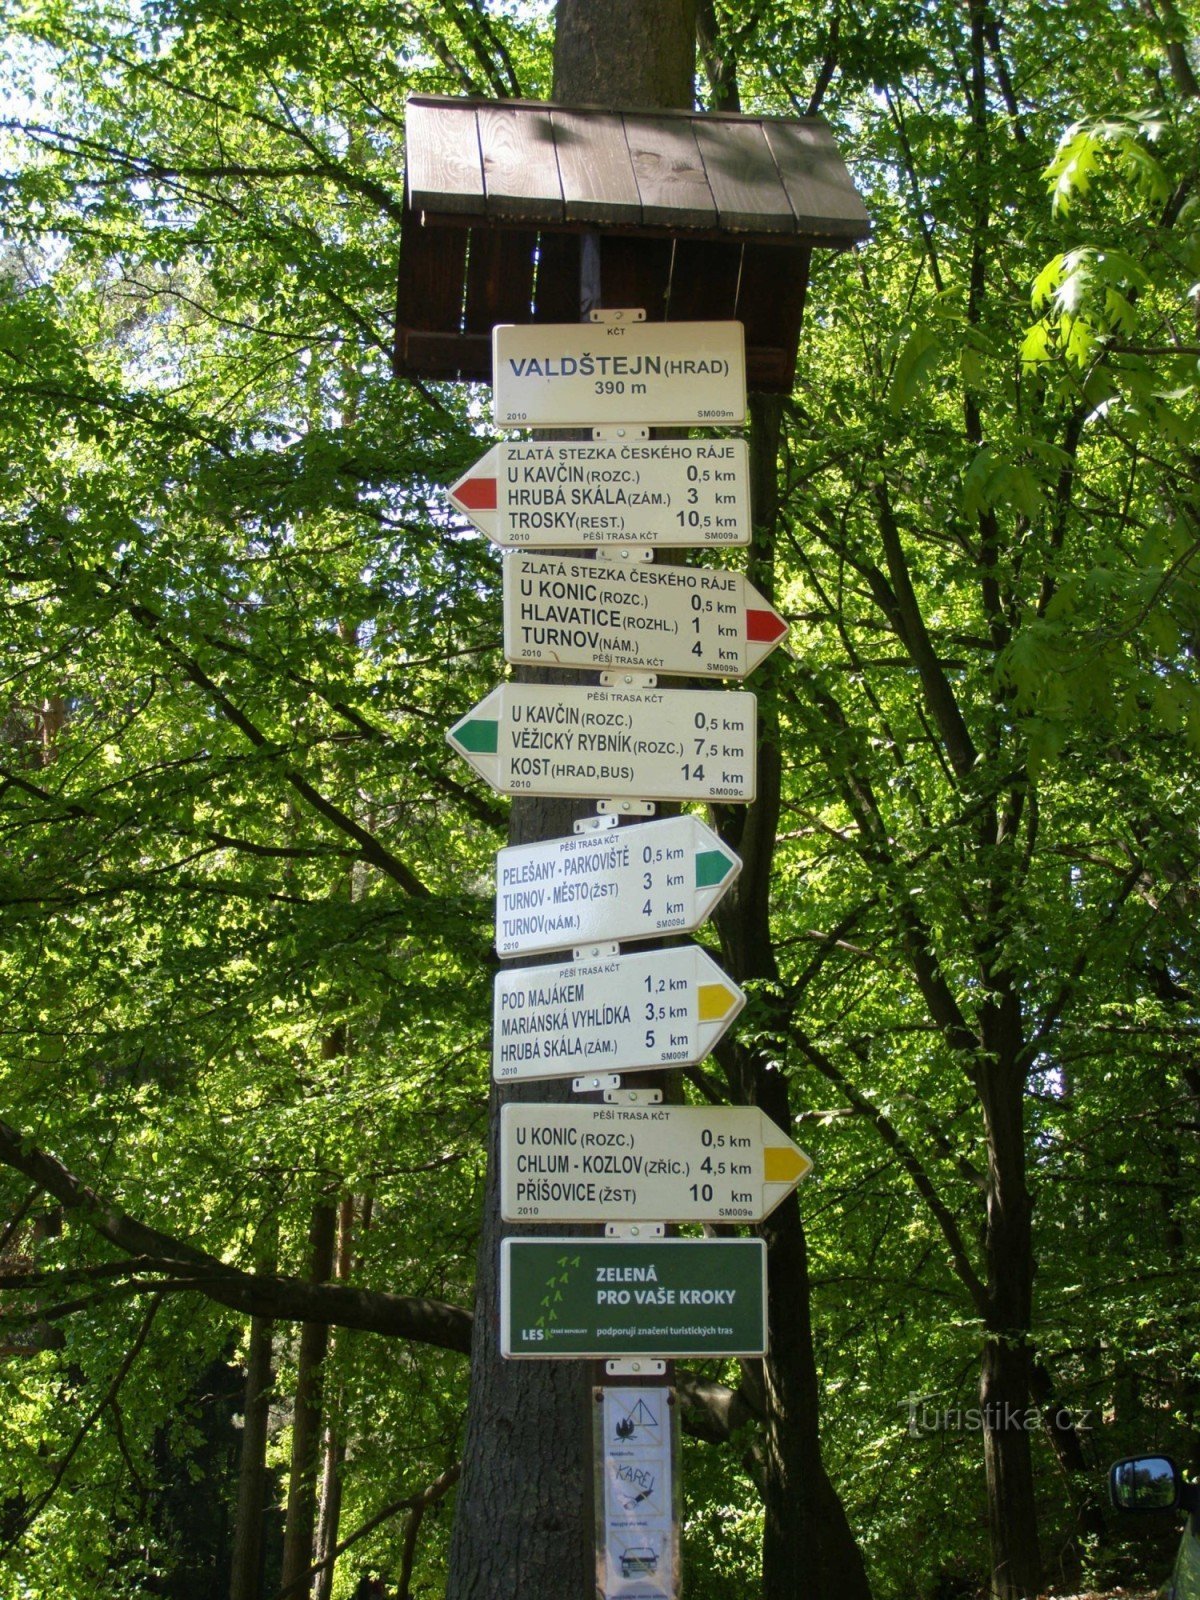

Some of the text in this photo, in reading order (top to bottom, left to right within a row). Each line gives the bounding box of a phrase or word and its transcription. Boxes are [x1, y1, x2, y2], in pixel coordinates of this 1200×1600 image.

[607, 327, 625, 336] KČT
[595, 381, 646, 394] 390 m
[697, 410, 734, 418] SM009m
[507, 444, 735, 461] ZLATÁ STEZKA ČESKÉHO RÁJE
[508, 468, 517, 483] U
[686, 465, 710, 483] 0,5
[715, 470, 736, 481] km
[508, 486, 566, 506] HRUBÁ
[687, 488, 698, 504] 3
[715, 493, 736, 504] km
[677, 511, 711, 528] 10,5
[716, 516, 737, 527] km
[583, 531, 658, 540] PĚŠÍ TRASA KČT
[705, 532, 738, 540] SM009a
[522, 562, 736, 591] ZLATÁ STEZKA ČESKÉHO RÁJE
[521, 579, 532, 596] U
[691, 595, 713, 613] 0,5
[717, 602, 737, 614] km
[692, 617, 700, 633] 1
[718, 625, 738, 637] km
[522, 650, 541, 658] 2010
[692, 642, 703, 657] 4
[718, 649, 738, 660] km
[593, 653, 664, 667] PĚŠÍ TRASA KČT
[707, 663, 738, 672] SM009b
[587, 692, 663, 703] PĚŠÍ TRASA KČT
[512, 706, 521, 723] U
[694, 712, 718, 730] 0,5
[722, 719, 744, 731] km
[512, 728, 572, 750] VĚŽICKÝ
[694, 739, 718, 757] 7,5
[722, 746, 744, 757] km
[681, 764, 705, 781] 14
[722, 772, 743, 784] km
[510, 780, 531, 788] 2010
[709, 788, 743, 796] SM009c
[560, 835, 619, 852] PĚŠÍ TRASA KČT
[503, 860, 556, 886] PELEŠANY
[564, 848, 629, 877] PARKOVIŠTĚ
[643, 846, 662, 863] 0,5
[666, 848, 684, 860] km
[503, 887, 545, 910] TURNOV
[643, 873, 652, 889] 3
[666, 874, 684, 886] km
[642, 899, 652, 916] 4
[666, 901, 684, 914] km
[656, 918, 685, 928] SM009d
[503, 942, 518, 950] 2010
[560, 964, 619, 978] PĚŠÍ TRASA KČT
[502, 976, 687, 1010] POD MAJÁKEM 1,2 km
[502, 1003, 687, 1036] MARIÁNSKÁ VYHLÍDKA 3,5 km
[501, 1038, 540, 1062] HRUBÁ
[646, 1031, 655, 1048] 5
[670, 1034, 688, 1046] km
[501, 1067, 517, 1075] 2010
[593, 1110, 670, 1121] PĚŠÍ TRASA KČT
[517, 1128, 526, 1145] U
[701, 1130, 725, 1148] 0,5
[730, 1135, 751, 1147] km
[517, 1156, 569, 1173] CHLUM
[701, 1157, 726, 1175] 4,5
[731, 1162, 752, 1174] km
[689, 1185, 713, 1202] 10
[731, 1190, 752, 1202] km
[718, 1208, 752, 1216] SM009e
[596, 1264, 657, 1282] ZELENÁ
[597, 1287, 736, 1305] PRO VAŠE KROKY
[597, 1327, 636, 1337] podporují
[638, 1327, 668, 1335] značení
[670, 1326, 715, 1335] turistických
